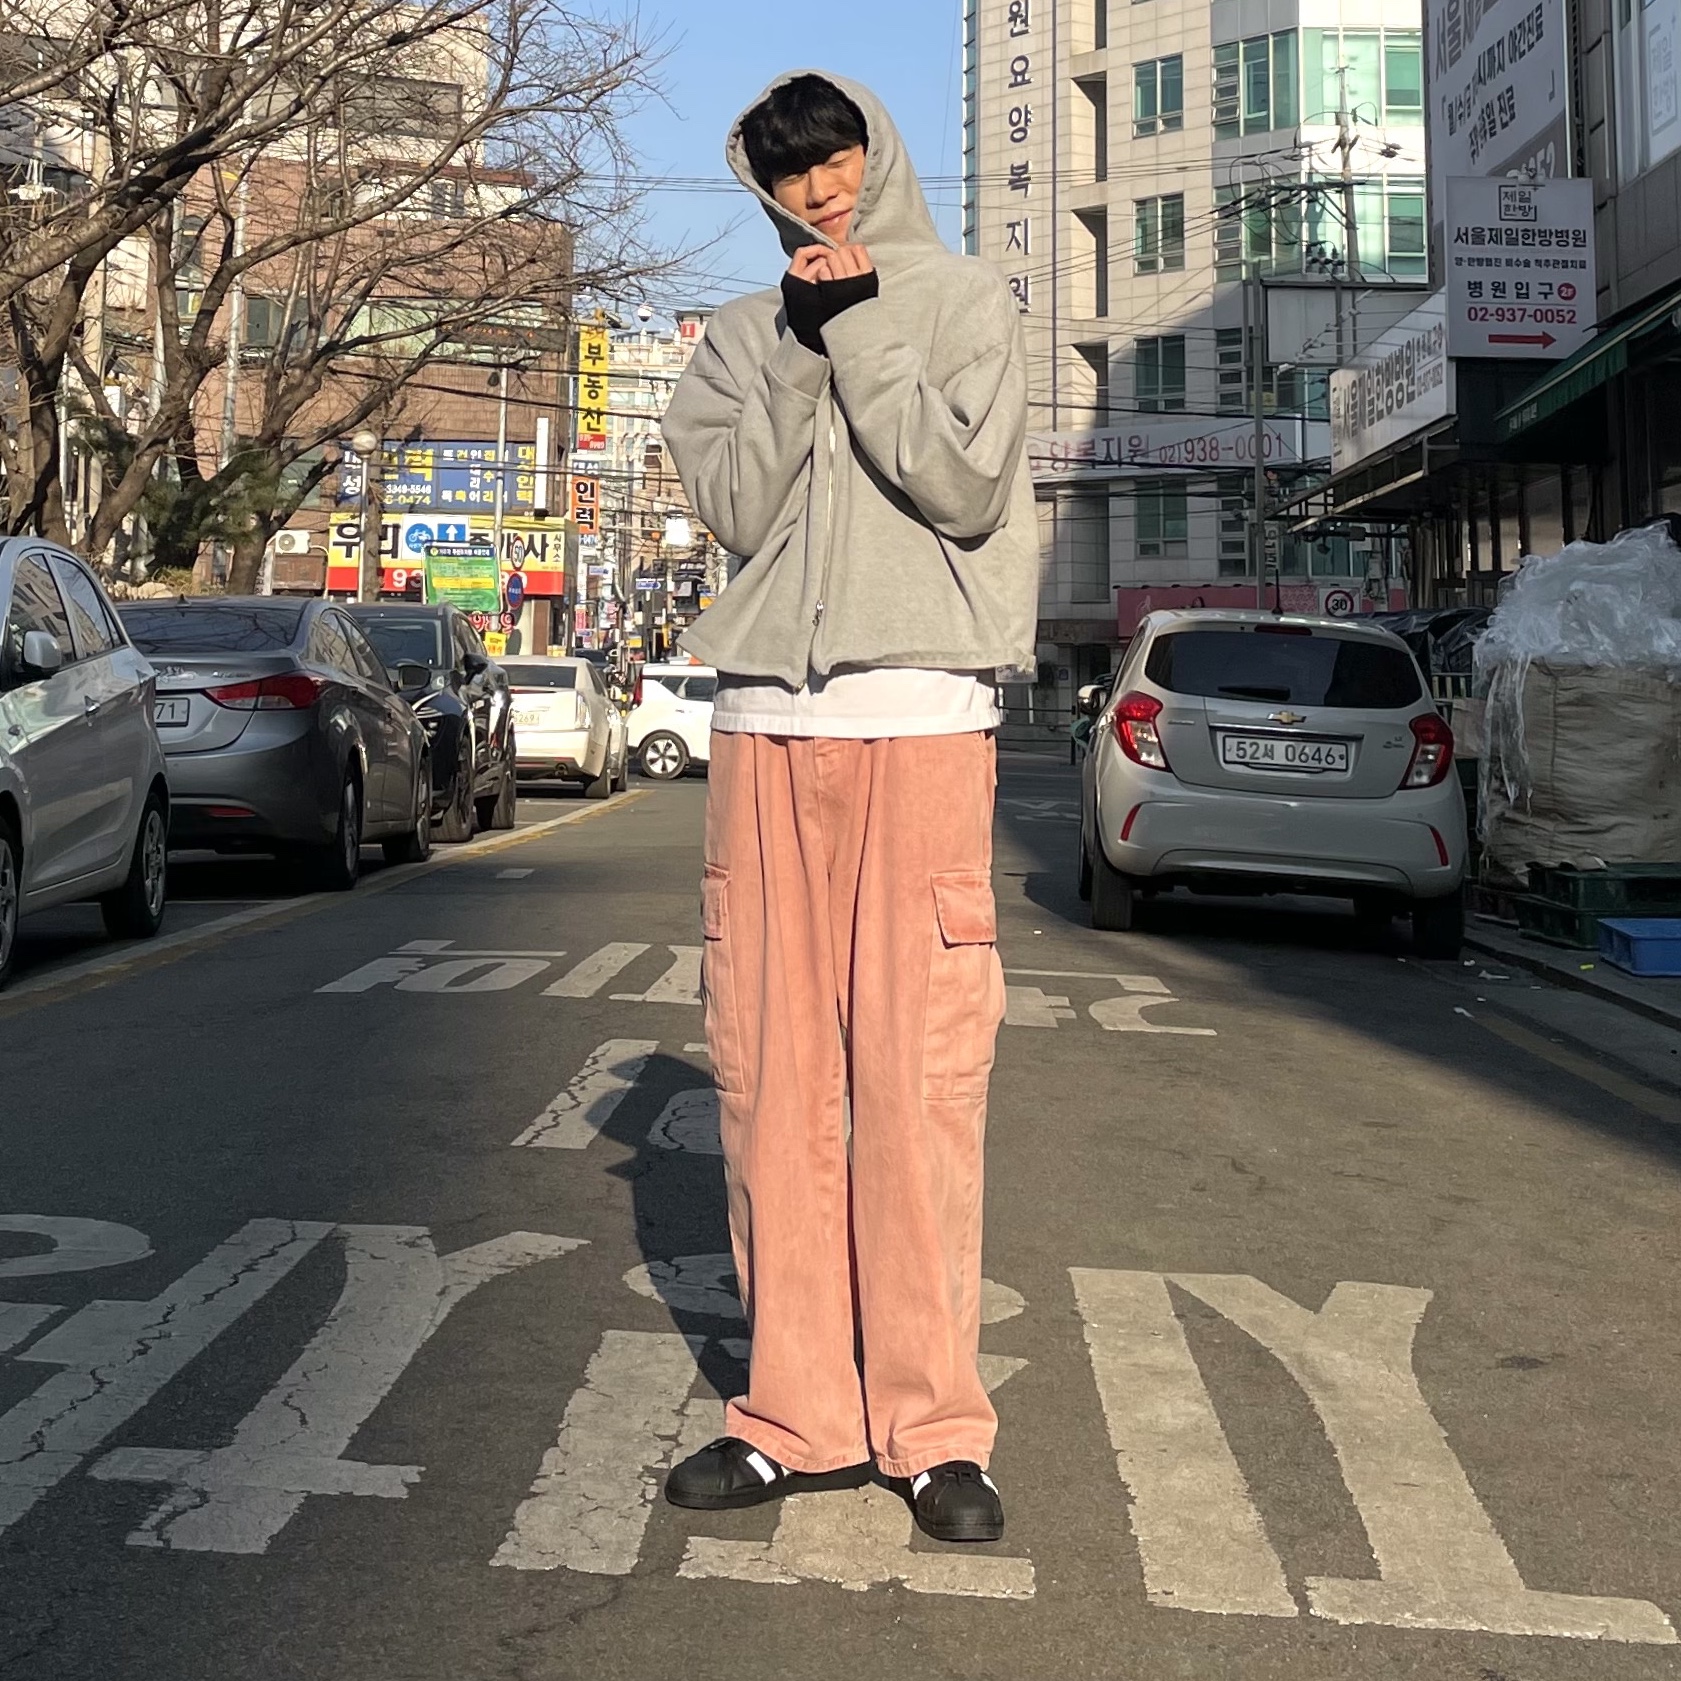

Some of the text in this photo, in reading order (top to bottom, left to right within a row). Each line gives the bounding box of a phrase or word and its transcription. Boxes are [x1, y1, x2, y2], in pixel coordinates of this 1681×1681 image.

[1502, 190, 1532, 203] 제일
[1503, 204, 1533, 217] 한방
[1454, 226, 1587, 248] 서울제일한방병원
[1467, 307, 1577, 324] 02-937-0052
[576, 481, 595, 530] 인력
[1331, 598, 1348, 611] 30
[1285, 742, 1336, 766] 0646
